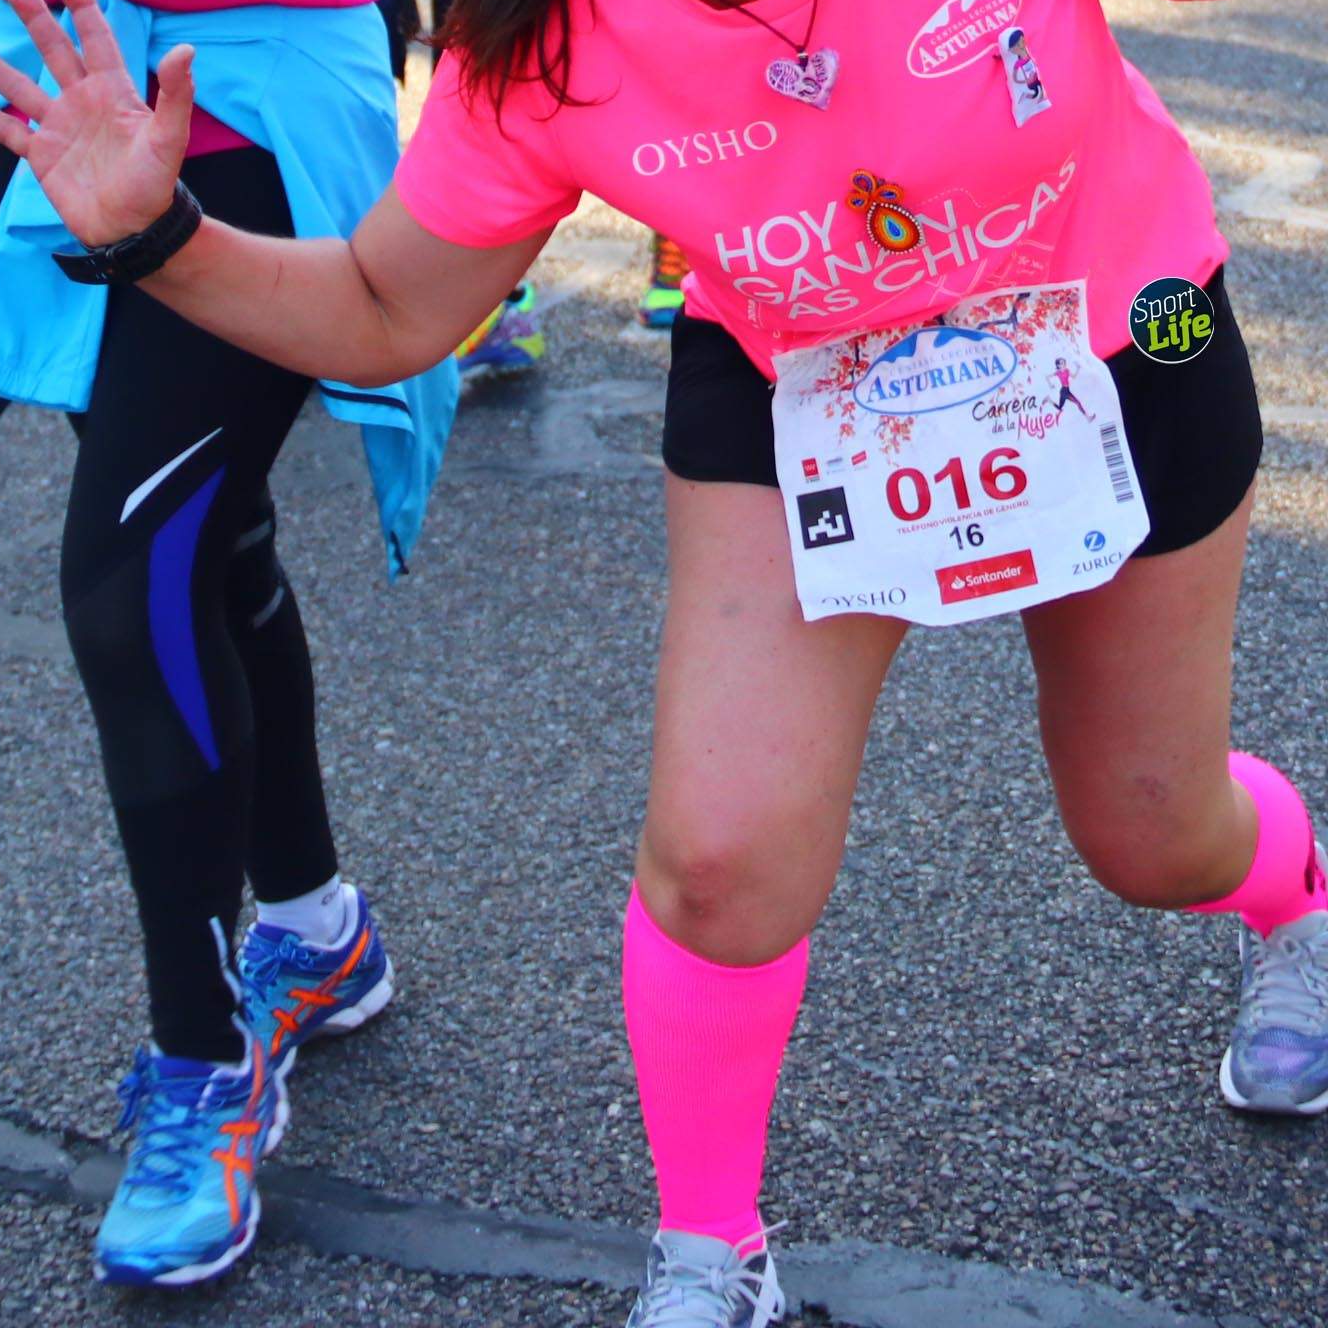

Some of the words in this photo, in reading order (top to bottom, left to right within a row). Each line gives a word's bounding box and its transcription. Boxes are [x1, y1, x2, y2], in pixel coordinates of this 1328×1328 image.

[918, 1, 1018, 74] ASTURIANA
[632, 120, 778, 177] OYSHO
[714, 201, 838, 273] HOY
[733, 199, 959, 305] GANN
[787, 288, 860, 322] AS
[873, 154, 1077, 293] CHICAS
[866, 354, 1007, 404] ASTURIANA
[972, 395, 1038, 421] Carrera
[1017, 405, 1063, 440] Mujer
[885, 446, 1028, 522] 016
[939, 512, 983, 528] VIOLENCIA
[983, 508, 995, 516] DE
[949, 523, 984, 550] 16
[966, 565, 1022, 587] Santander
